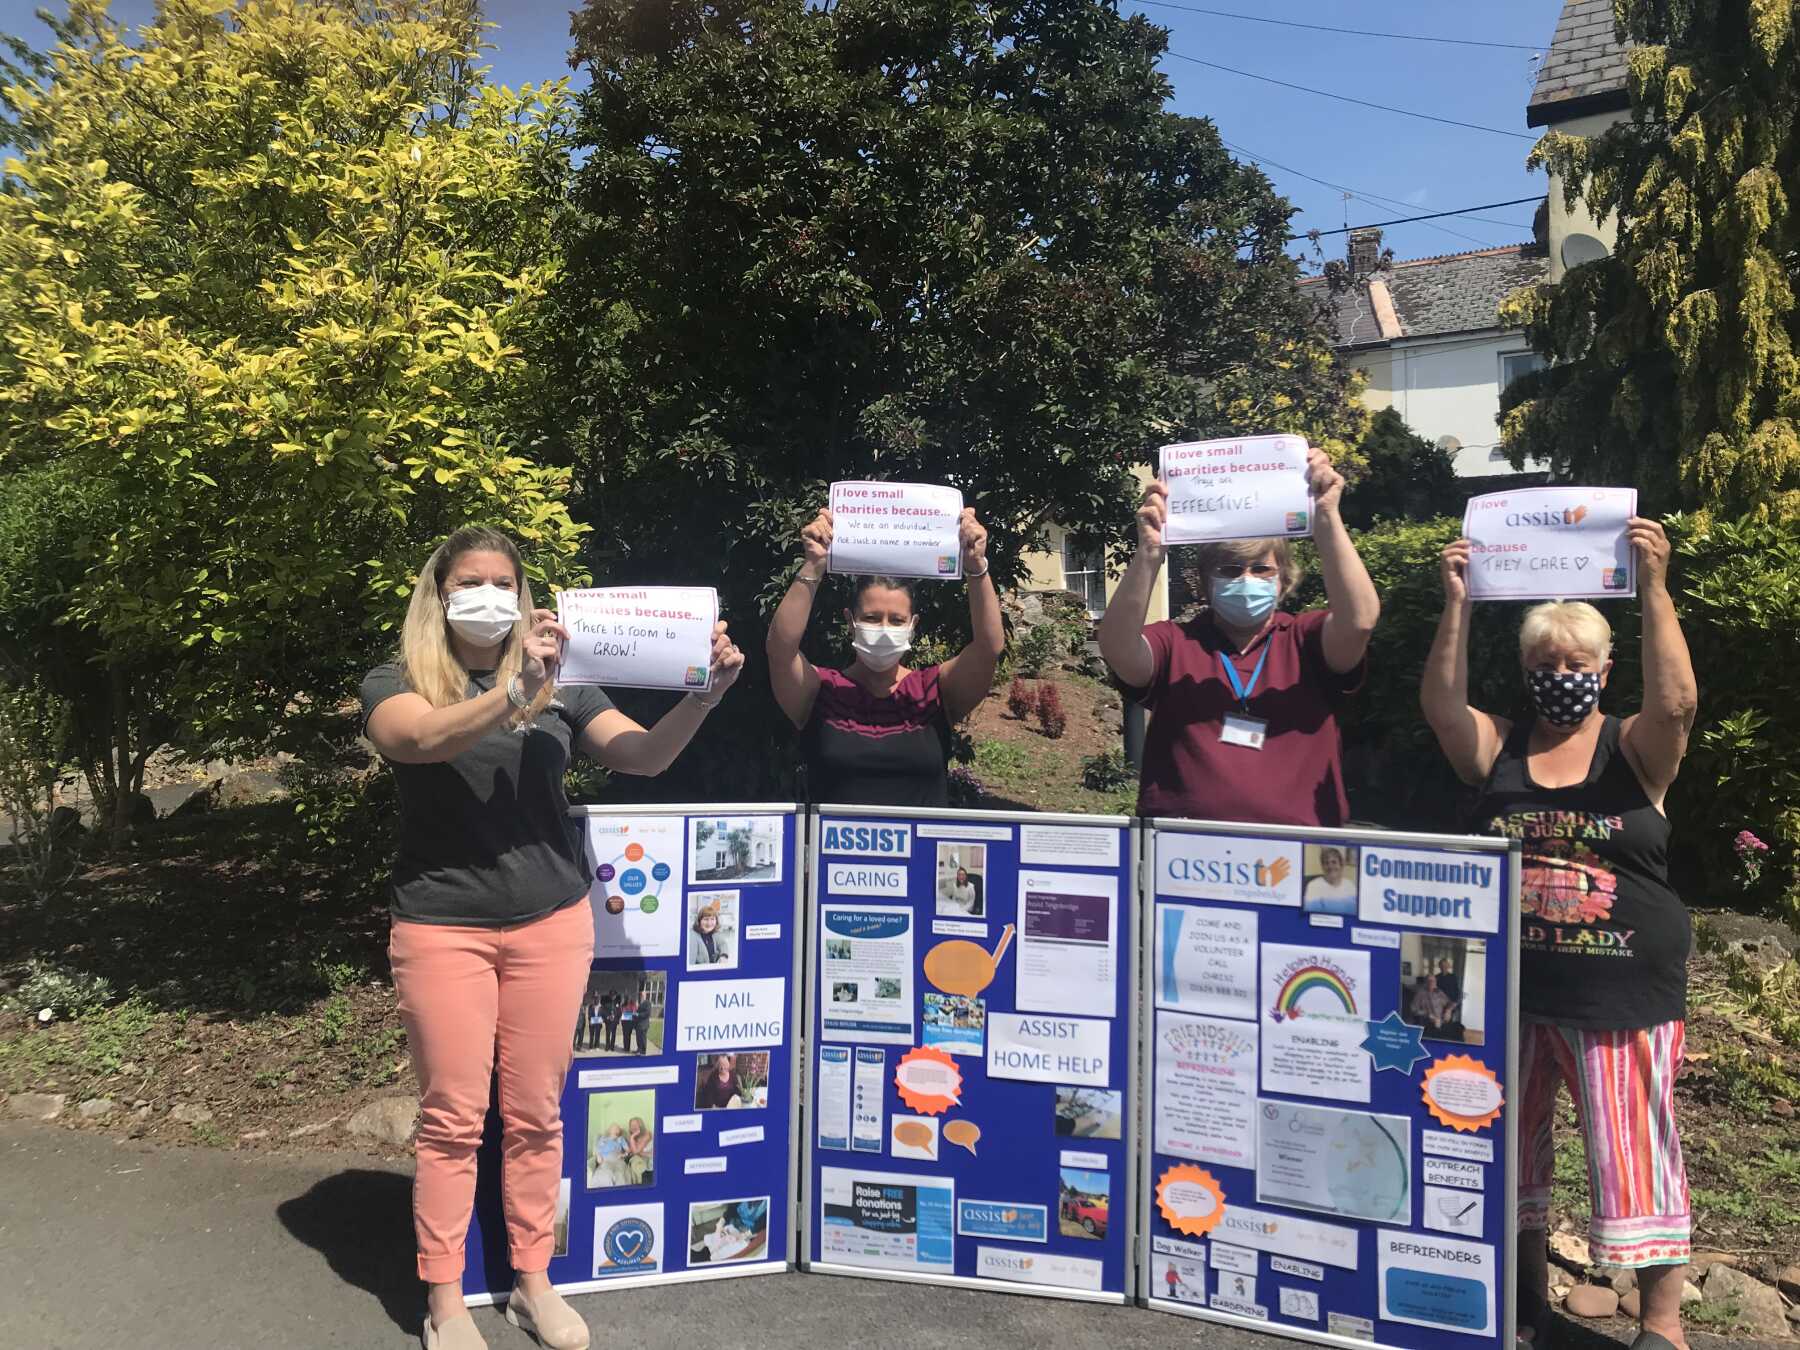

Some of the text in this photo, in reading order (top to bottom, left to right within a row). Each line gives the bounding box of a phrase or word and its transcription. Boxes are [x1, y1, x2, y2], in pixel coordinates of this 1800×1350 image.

[1175, 449, 1203, 460] love
[1207, 445, 1243, 457] small
[1168, 462, 1226, 477] charities
[843, 488, 868, 498] love
[871, 489, 904, 499] small
[835, 504, 888, 515] charities
[1171, 490, 1259, 515] EFFECTIVE!
[1481, 499, 1508, 510] love
[1472, 541, 1528, 554] because
[1482, 555, 1569, 572] THEY CARE
[571, 591, 604, 599] love
[608, 591, 647, 600] small
[666, 627, 676, 640] to
[593, 641, 637, 657] GROW!
[824, 826, 908, 853] ASSIST
[1530, 824, 1577, 838] JUST
[1582, 826, 1612, 840] AN
[1168, 850, 1267, 887] assist
[1365, 853, 1493, 888] Community
[834, 871, 900, 888] CARING
[1383, 888, 1472, 919] Support
[833, 914, 852, 923] Caring
[1224, 921, 1242, 930] AND
[1229, 935, 1241, 943] AS
[1555, 928, 1636, 948] LADY
[1273, 955, 1357, 991] Helping Hands
[715, 992, 755, 1010] NAIL
[684, 1020, 781, 1041] TRIMMING
[1019, 1019, 1080, 1039] ASSIST
[994, 1049, 1104, 1075] HOME HELP
[1426, 1159, 1480, 1174] OUTREACH
[1428, 1173, 1479, 1188] BENEFITS
[855, 1186, 880, 1198] Raise
[855, 1197, 902, 1210] donations
[1156, 1240, 1171, 1252] Dog
[1390, 1241, 1482, 1265] BEFRIENDERS
[1273, 1259, 1321, 1279] ENABLING
[1212, 1298, 1265, 1318] GARDENING
